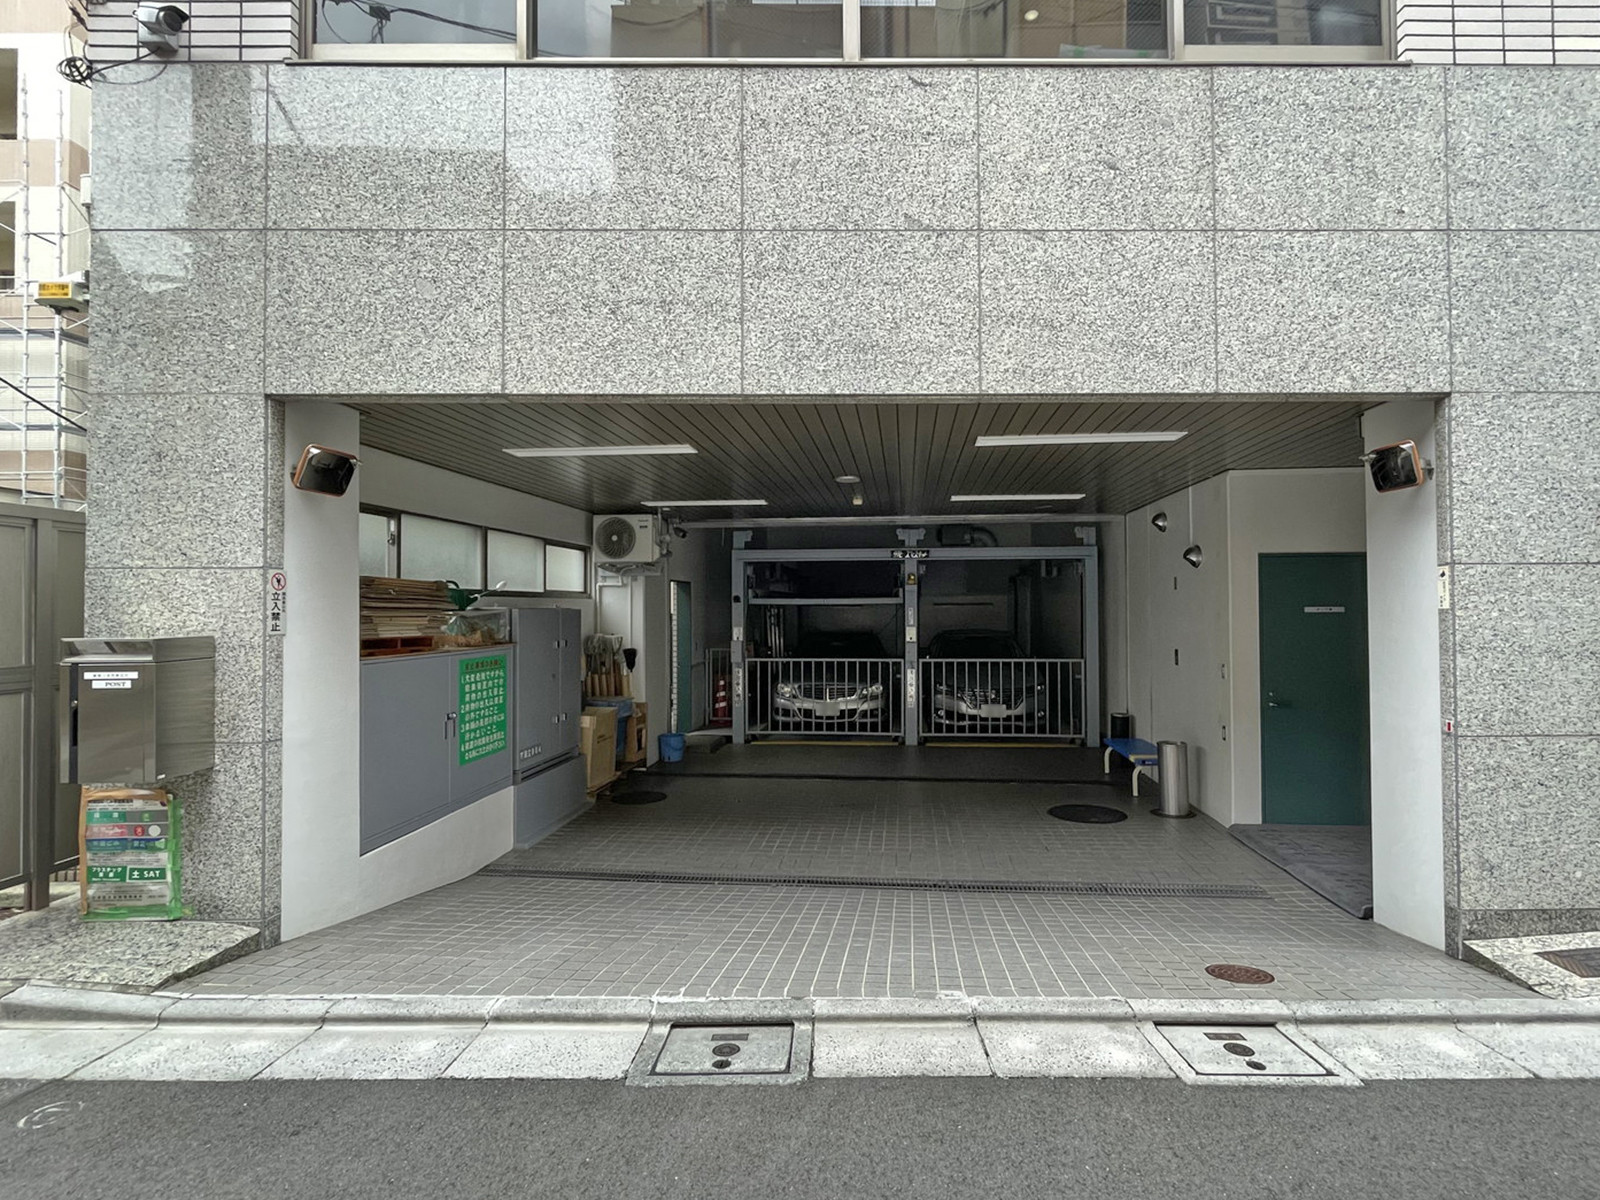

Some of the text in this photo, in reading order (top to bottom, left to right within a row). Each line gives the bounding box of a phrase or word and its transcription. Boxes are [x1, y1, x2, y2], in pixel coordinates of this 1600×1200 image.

[271, 592, 281, 631] 立入禁止
[132, 870, 161, 879] 土 SAT
